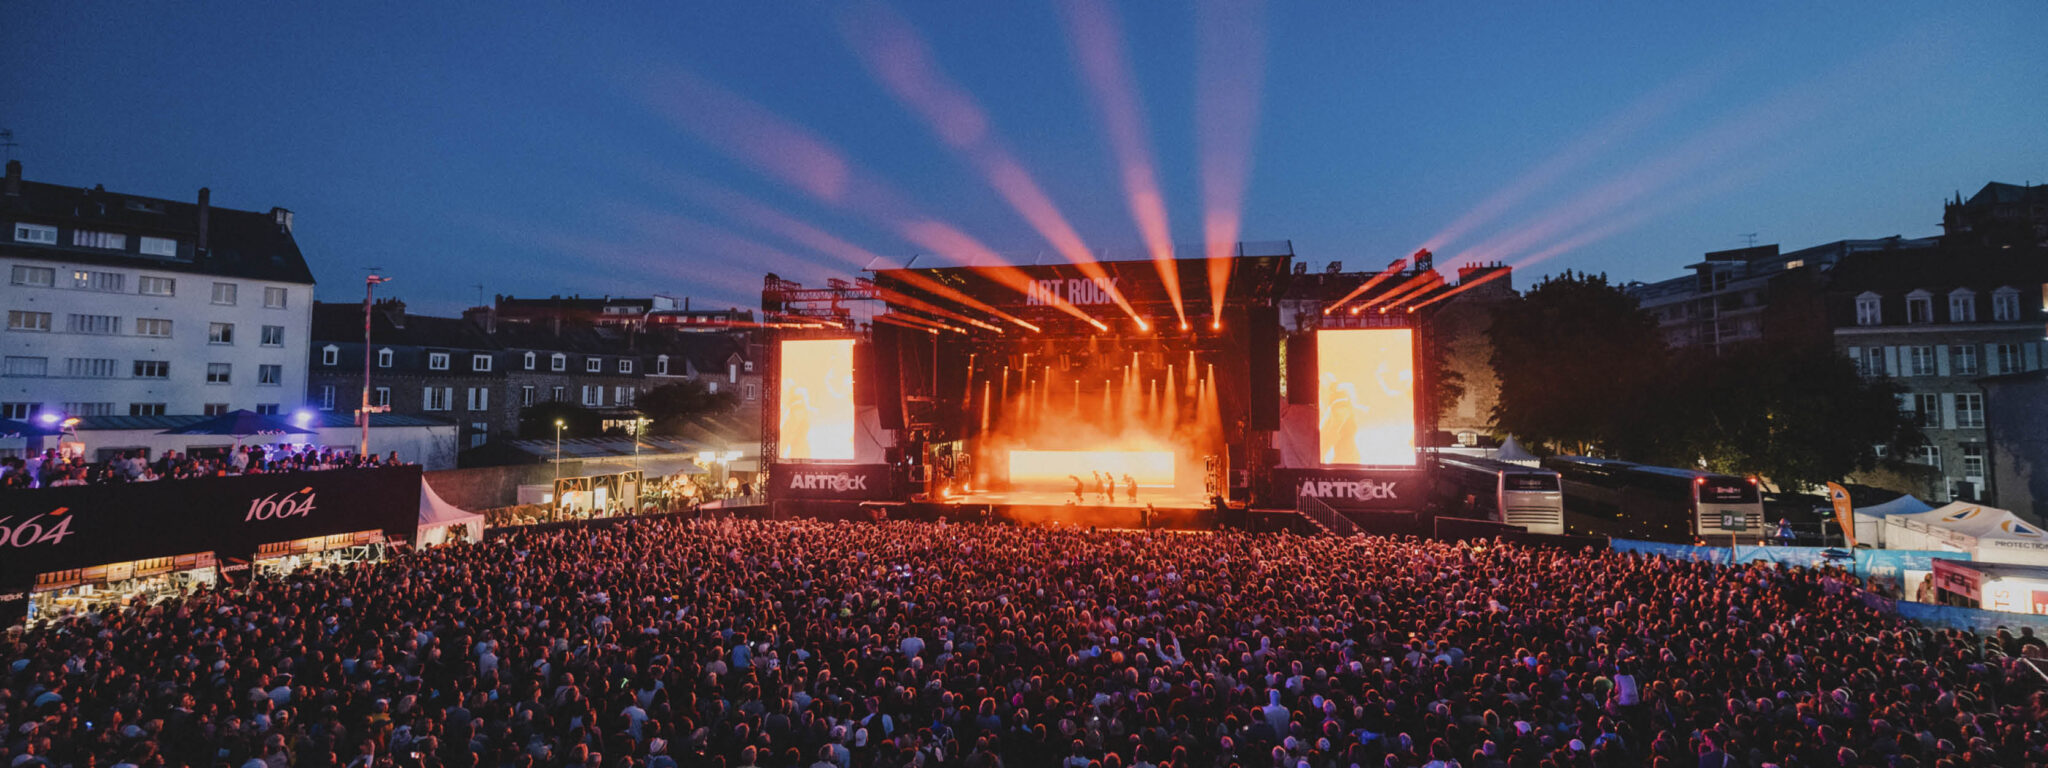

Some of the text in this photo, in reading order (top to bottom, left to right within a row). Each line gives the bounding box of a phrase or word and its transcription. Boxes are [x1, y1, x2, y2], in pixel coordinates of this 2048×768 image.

[1026, 277, 1118, 306] ART ROCK
[245, 489, 317, 521] 1664
